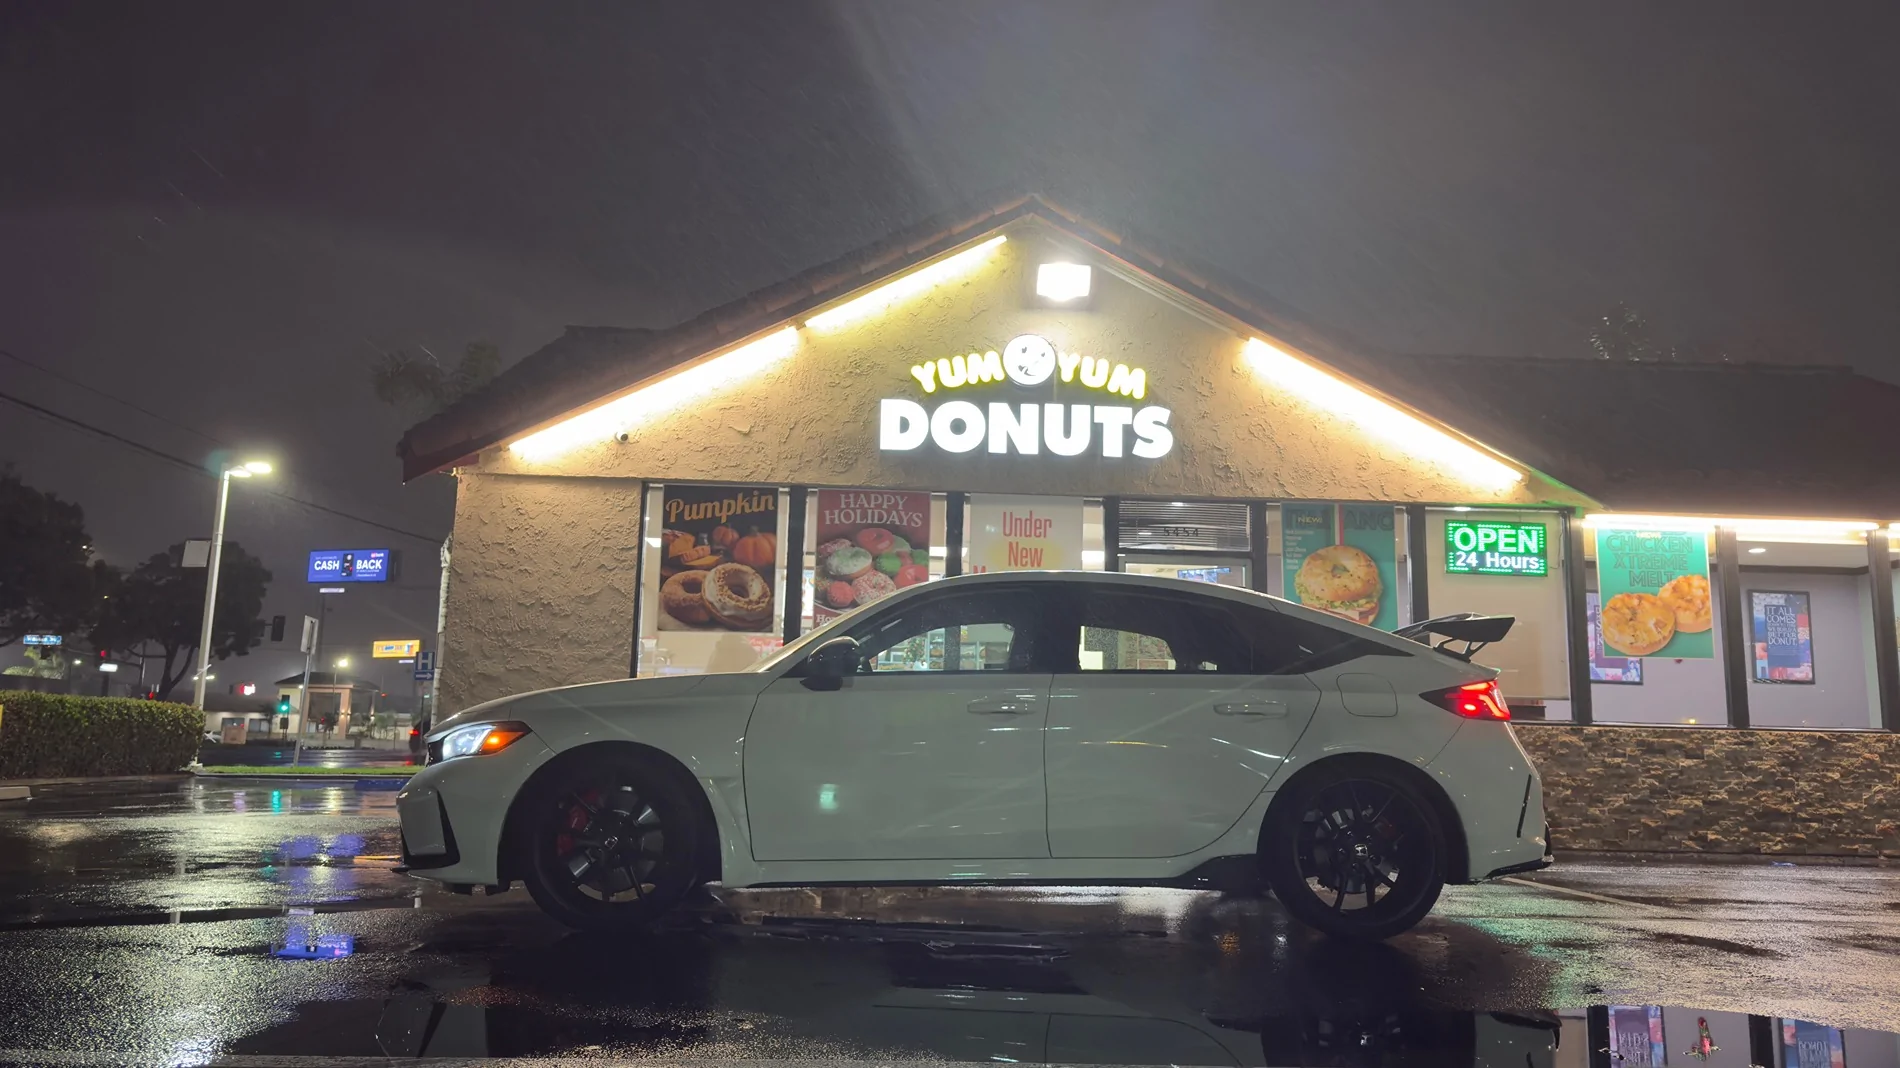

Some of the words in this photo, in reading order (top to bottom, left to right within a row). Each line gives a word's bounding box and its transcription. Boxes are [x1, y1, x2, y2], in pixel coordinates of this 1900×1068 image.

[910, 350, 1005, 393] YUM
[1057, 351, 1147, 400] YUM
[879, 398, 1174, 459] DONUTS
[665, 490, 776, 523] Pumpkin
[840, 493, 908, 509] HAPPY
[824, 509, 923, 528] HOLIDAYS
[1002, 511, 1052, 538] Under
[1163, 527, 1200, 538] 5454
[1453, 526, 1539, 553] OPEN
[1606, 534, 1693, 553] CHICKEN
[1007, 541, 1044, 568] New
[1455, 550, 1478, 567] 24
[1485, 551, 1540, 569] Hours
[1613, 553, 1688, 571] XTREME
[314, 560, 340, 571] CASH
[356, 559, 383, 570] BACK
[1629, 570, 1675, 588] MELT
[1766, 615, 1797, 624] COMES
[1767, 606, 1777, 615] IT
[1778, 606, 1796, 616] ALL
[417, 652, 433, 670] H
